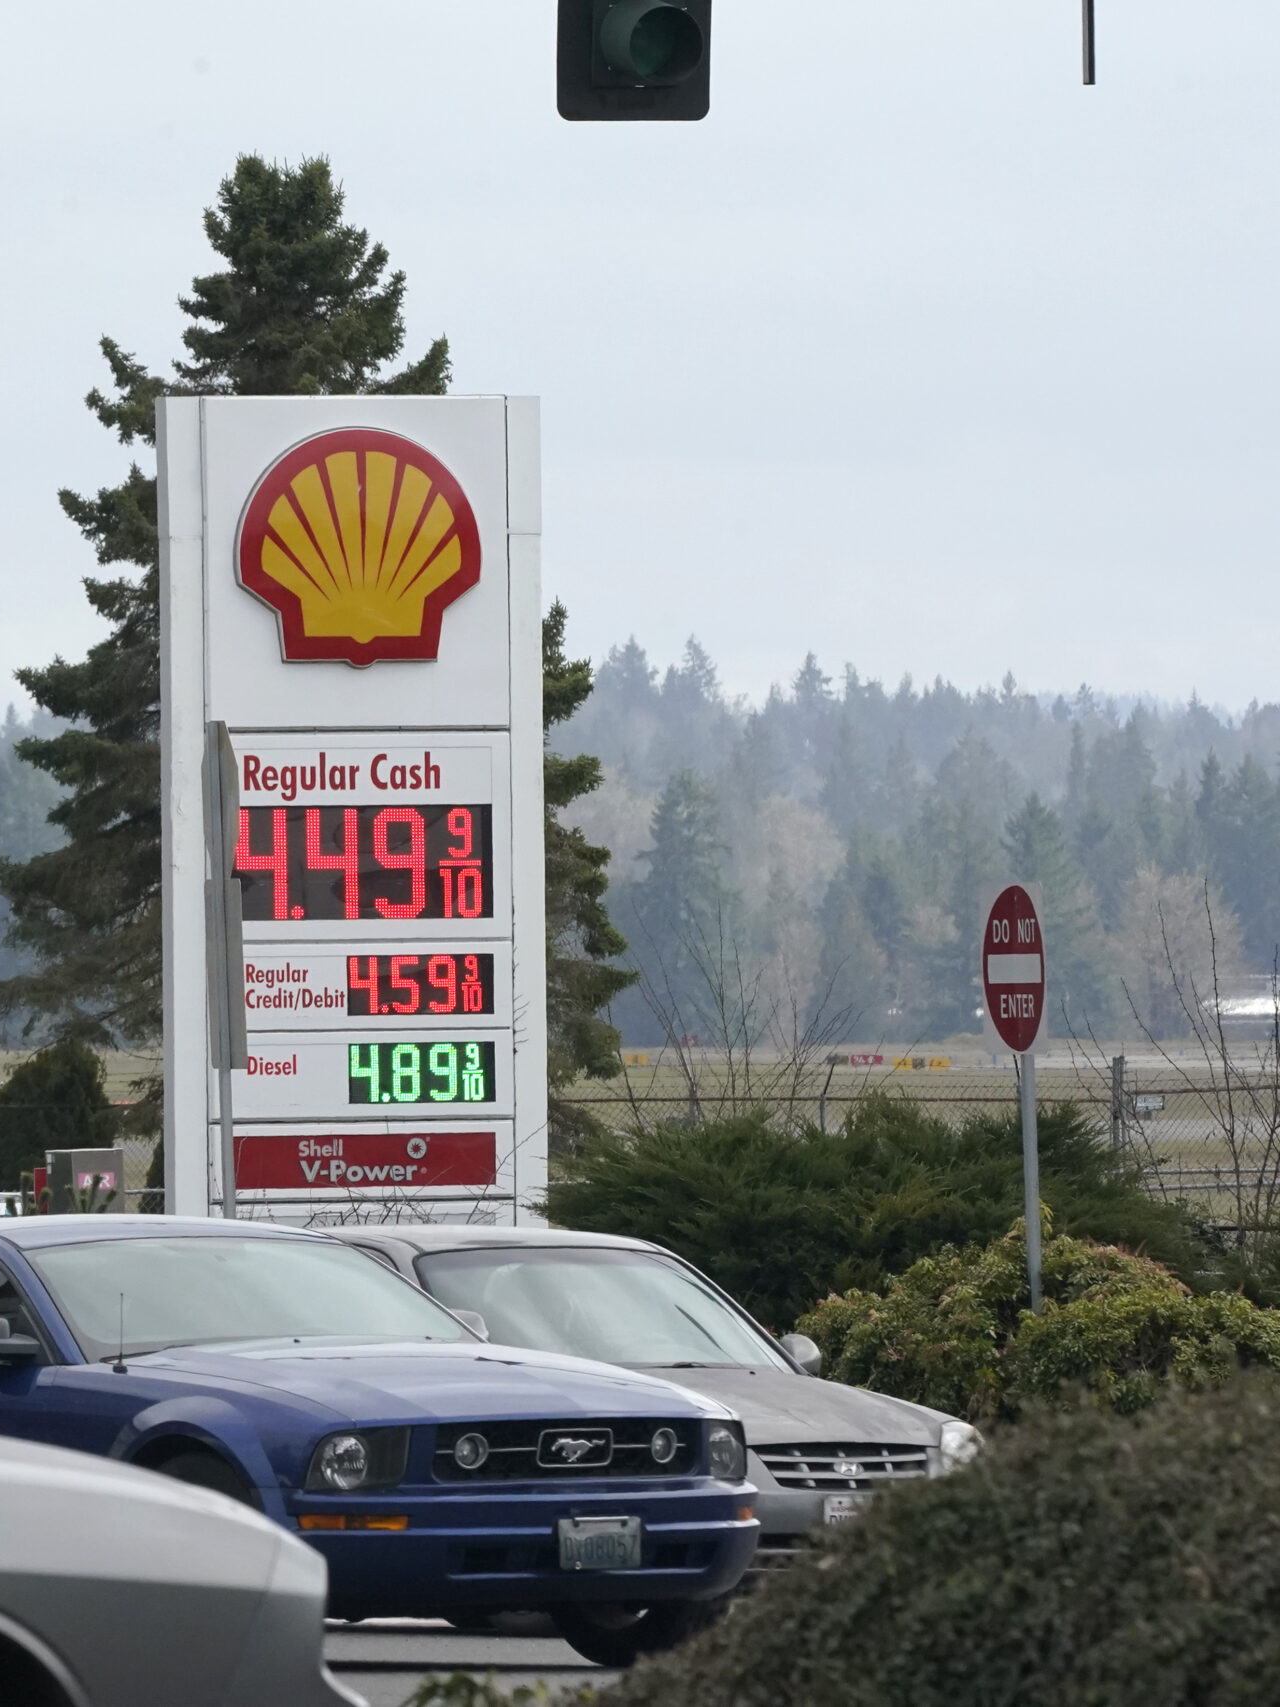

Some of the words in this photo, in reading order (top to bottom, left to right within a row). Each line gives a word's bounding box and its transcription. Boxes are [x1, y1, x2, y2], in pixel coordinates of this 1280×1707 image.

[243, 752, 360, 801] Regular
[370, 752, 441, 790] Cash
[993, 919, 1010, 943] DO
[1017, 919, 1036, 943] NOT
[245, 962, 309, 988] Regular
[245, 987, 345, 1010] Credit/Debit
[1000, 994, 1035, 1018] ENTER
[247, 1055, 297, 1075] Diesel
[298, 1139, 343, 1157] Shell
[299, 1160, 417, 1182] V-Power
